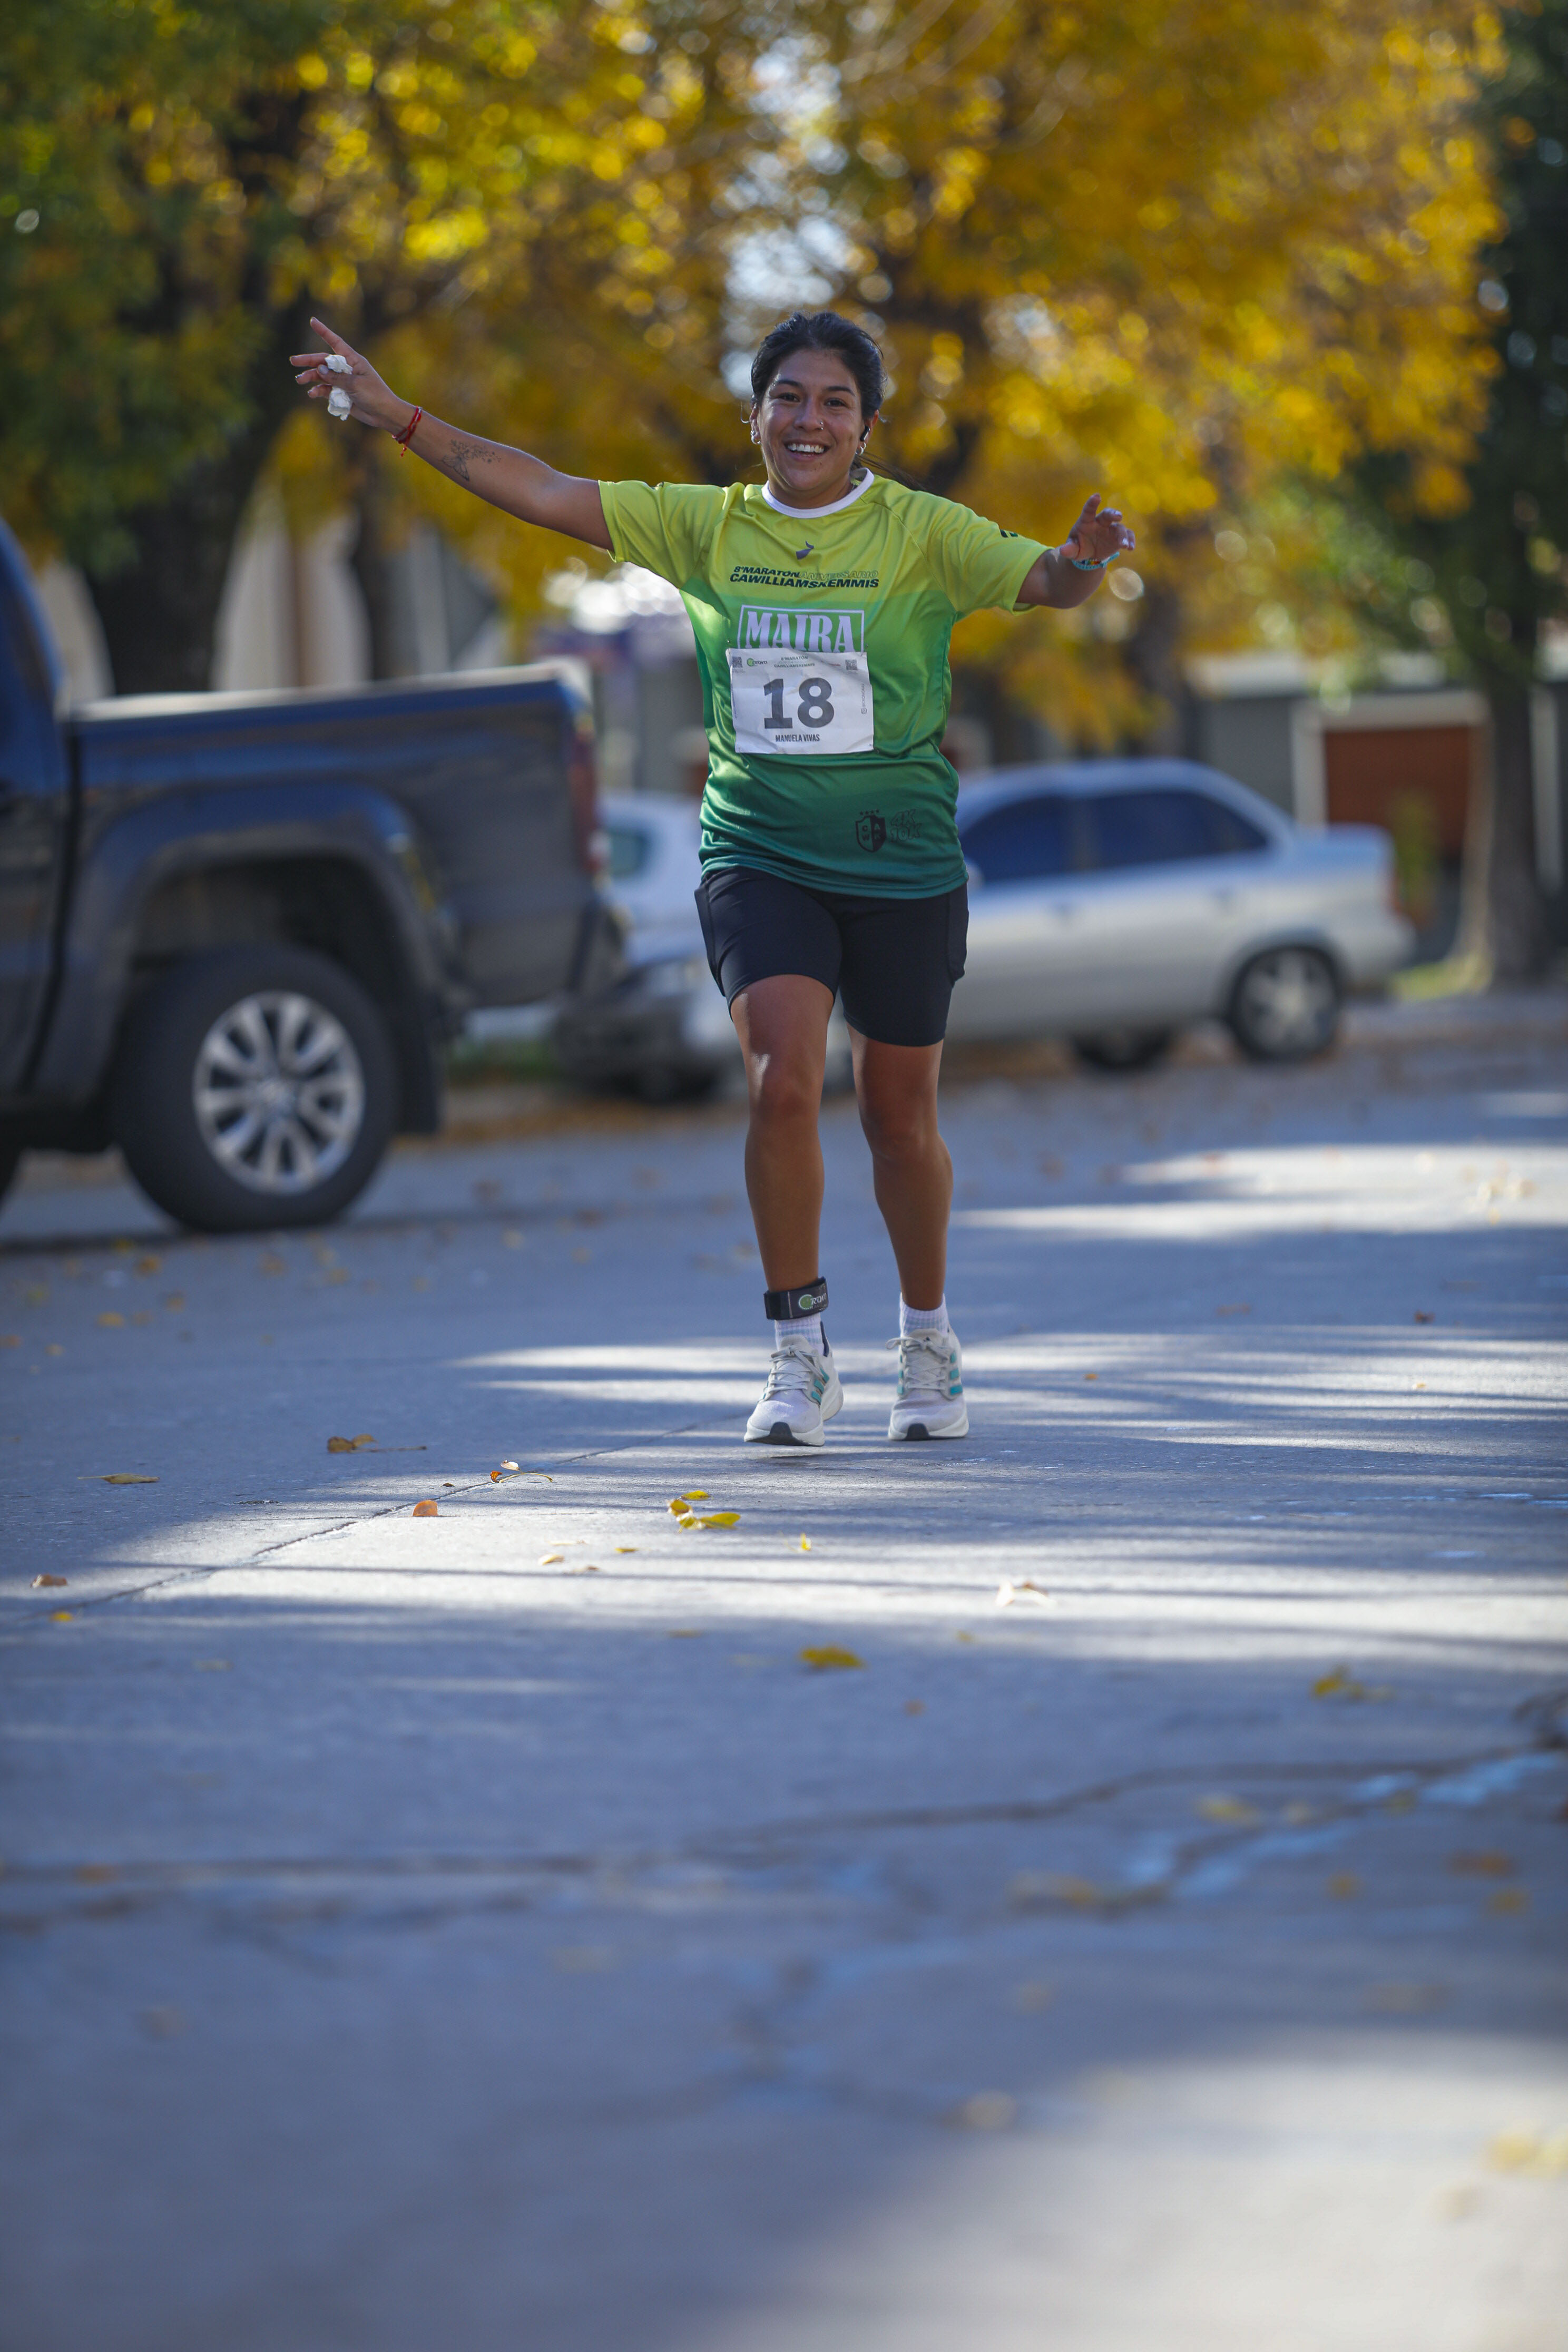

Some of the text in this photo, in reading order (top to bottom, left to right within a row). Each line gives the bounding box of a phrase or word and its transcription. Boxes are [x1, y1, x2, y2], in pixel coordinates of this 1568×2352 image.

[730, 573, 879, 588] CAWILLIAMSKEMMIS
[745, 611, 856, 652] MAIRA
[763, 678, 835, 729] 18
[890, 823, 922, 842] 10K
